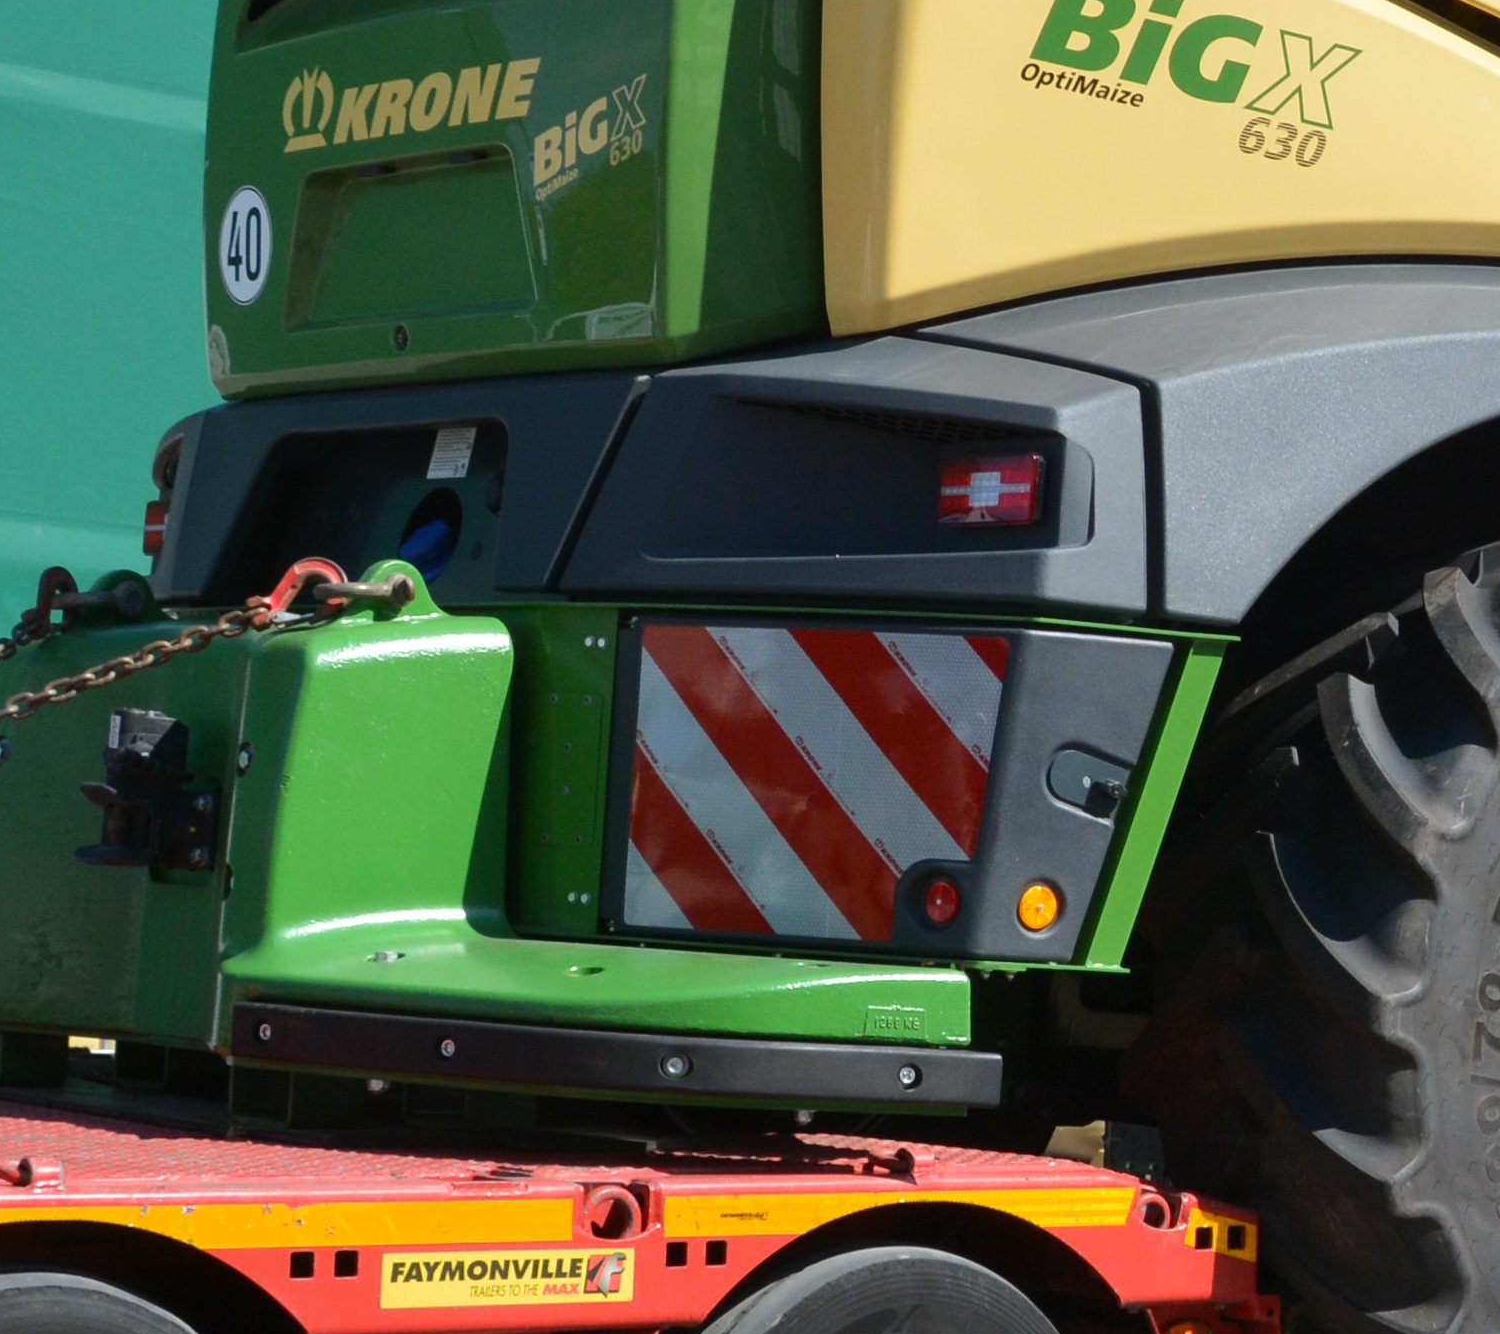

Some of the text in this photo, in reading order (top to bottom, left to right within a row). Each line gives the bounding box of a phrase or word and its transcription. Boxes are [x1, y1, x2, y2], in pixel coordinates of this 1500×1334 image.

[333, 57, 541, 145] KRONE
[1020, 62, 1144, 108] OptiMaize
[534, 96, 607, 186] BiG
[610, 129, 642, 166] 630
[1238, 117, 1328, 168] 630
[535, 168, 579, 201] OptiMaize
[225, 205, 261, 283] 40
[390, 1258, 583, 1283] FAYMONVILLE
[470, 1283, 580, 1297] TRAILERS TO THE MAX
